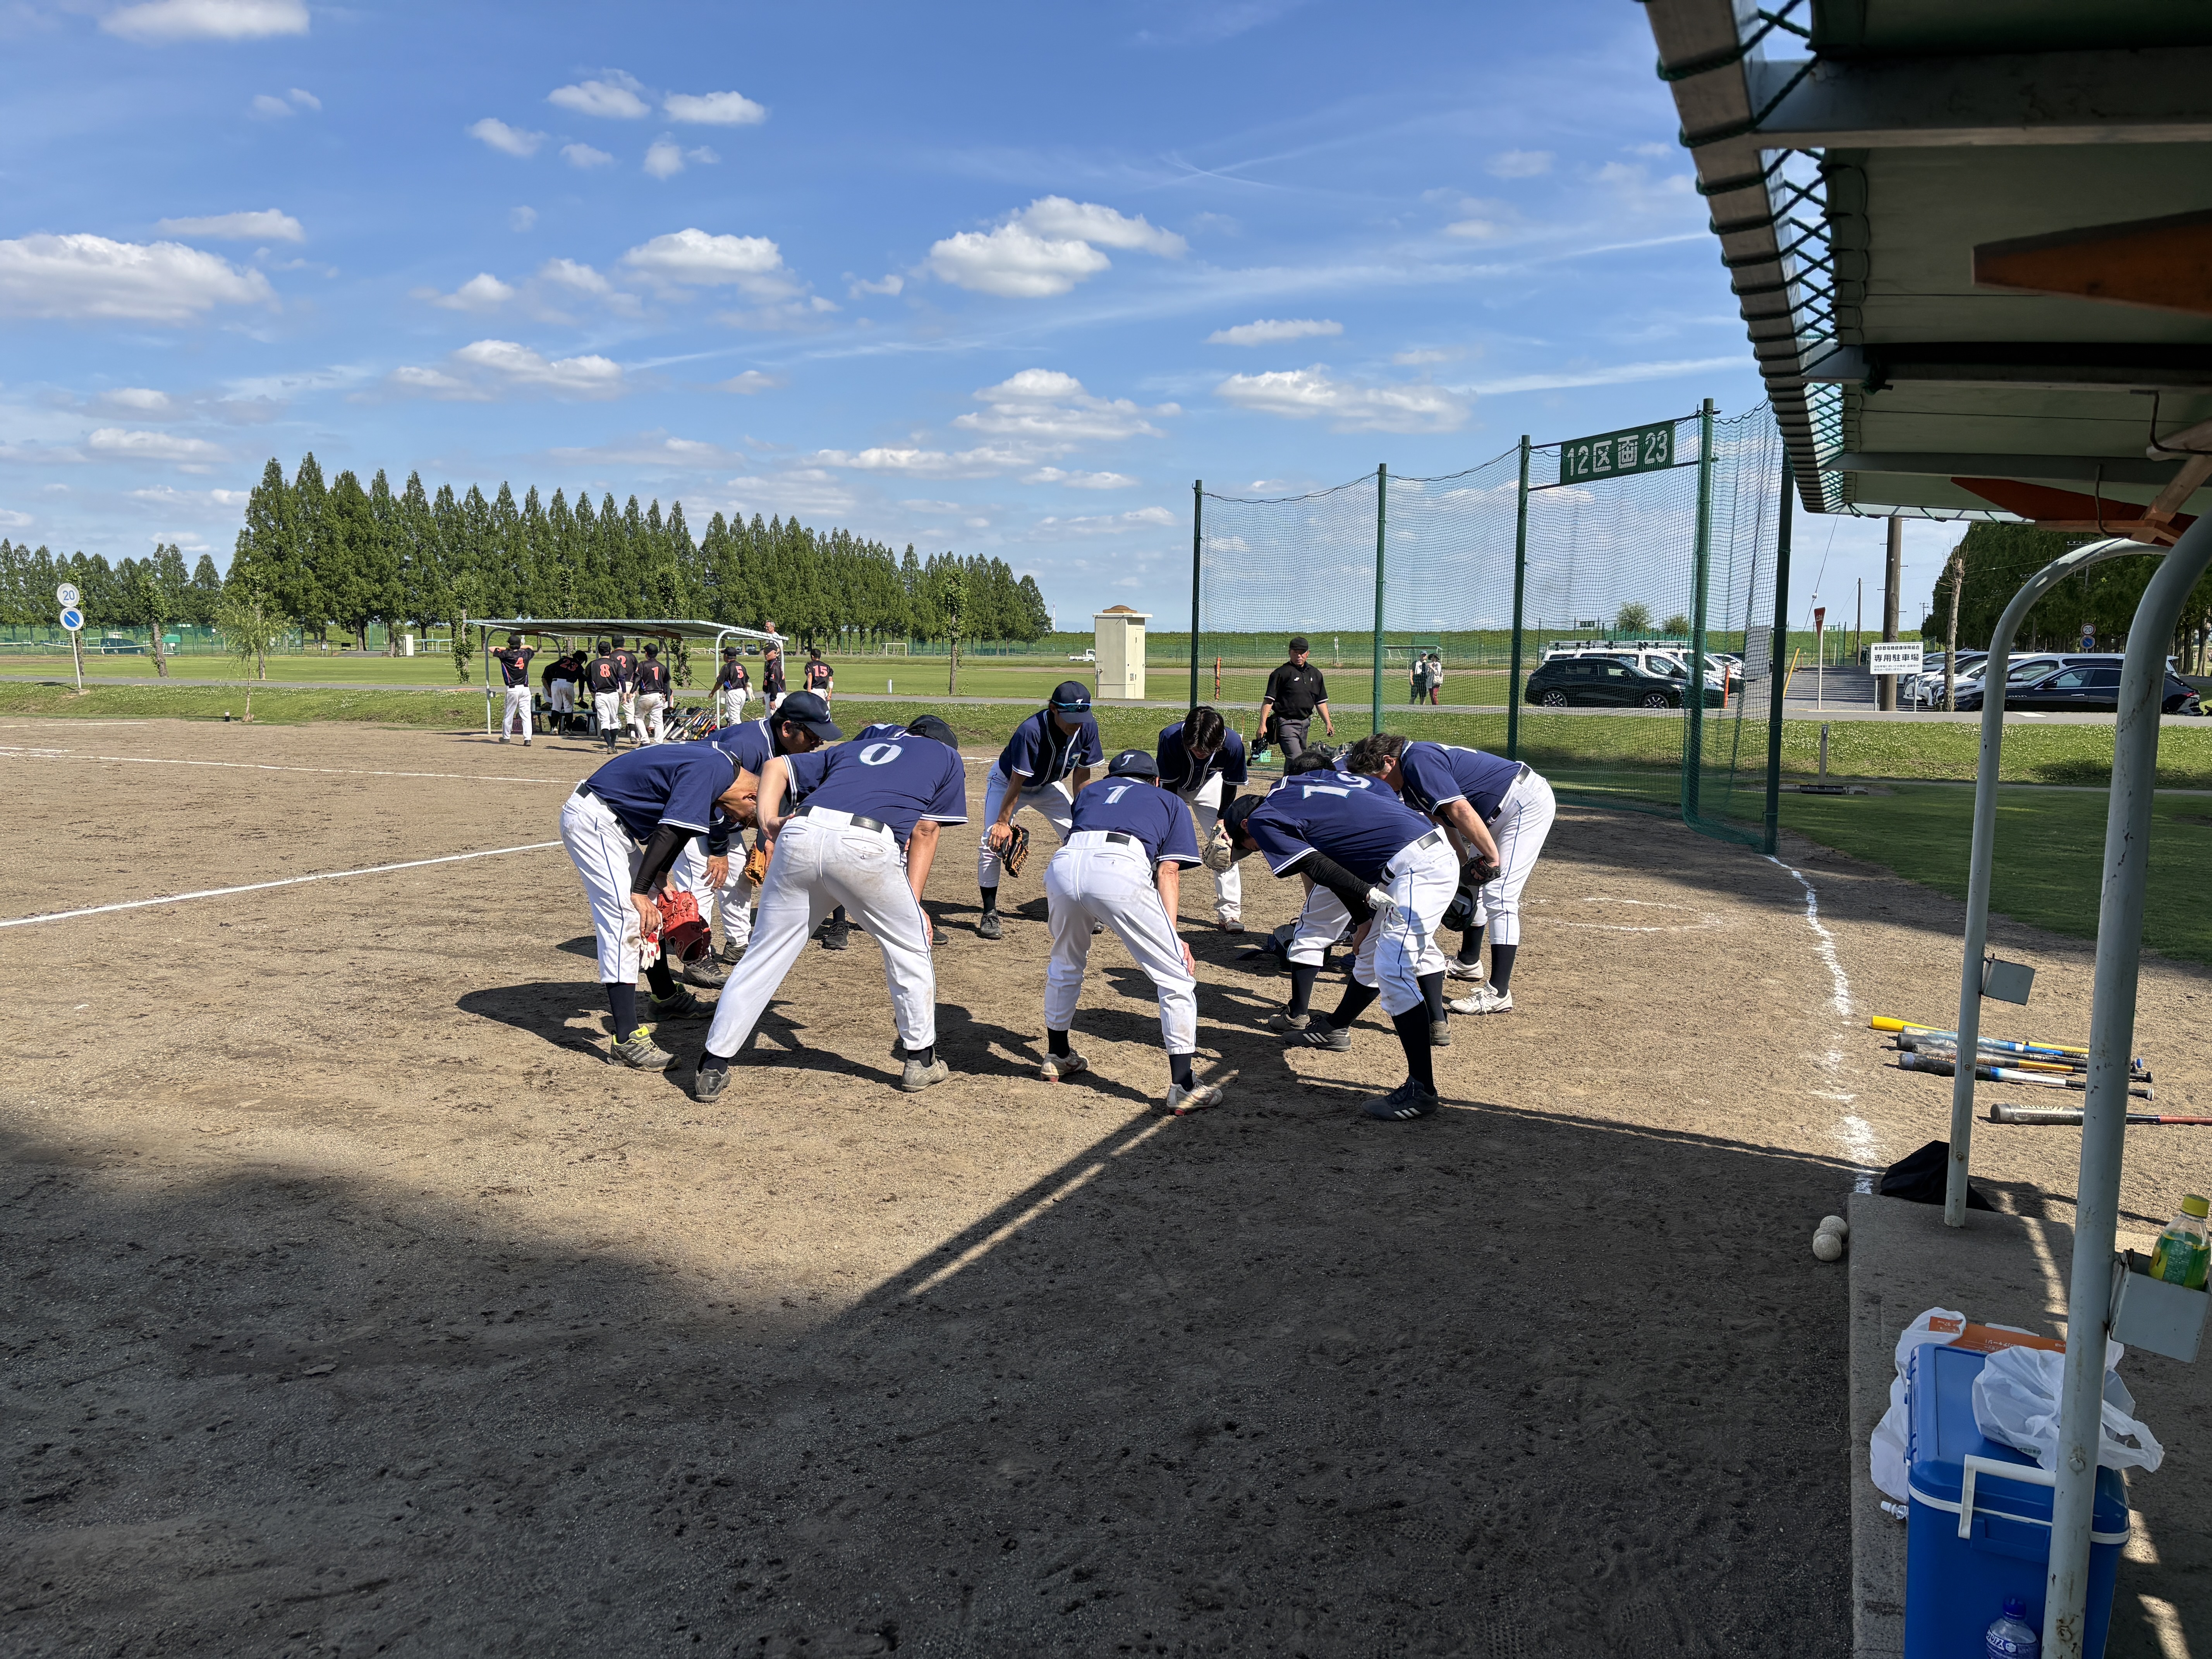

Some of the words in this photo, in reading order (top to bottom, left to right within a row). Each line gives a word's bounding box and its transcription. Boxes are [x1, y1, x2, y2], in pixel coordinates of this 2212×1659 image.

[63, 590, 75, 600] 20
[514, 657, 524, 670] 4
[1874, 654, 1919, 662] 専用駐車場
[560, 658, 578, 672] 23
[600, 664, 611, 678] 8
[813, 665, 828, 677] 15
[651, 666, 659, 680] 1
[735, 666, 744, 678] 5
[858, 743, 904, 766] 0
[1102, 785, 1135, 804] 1
